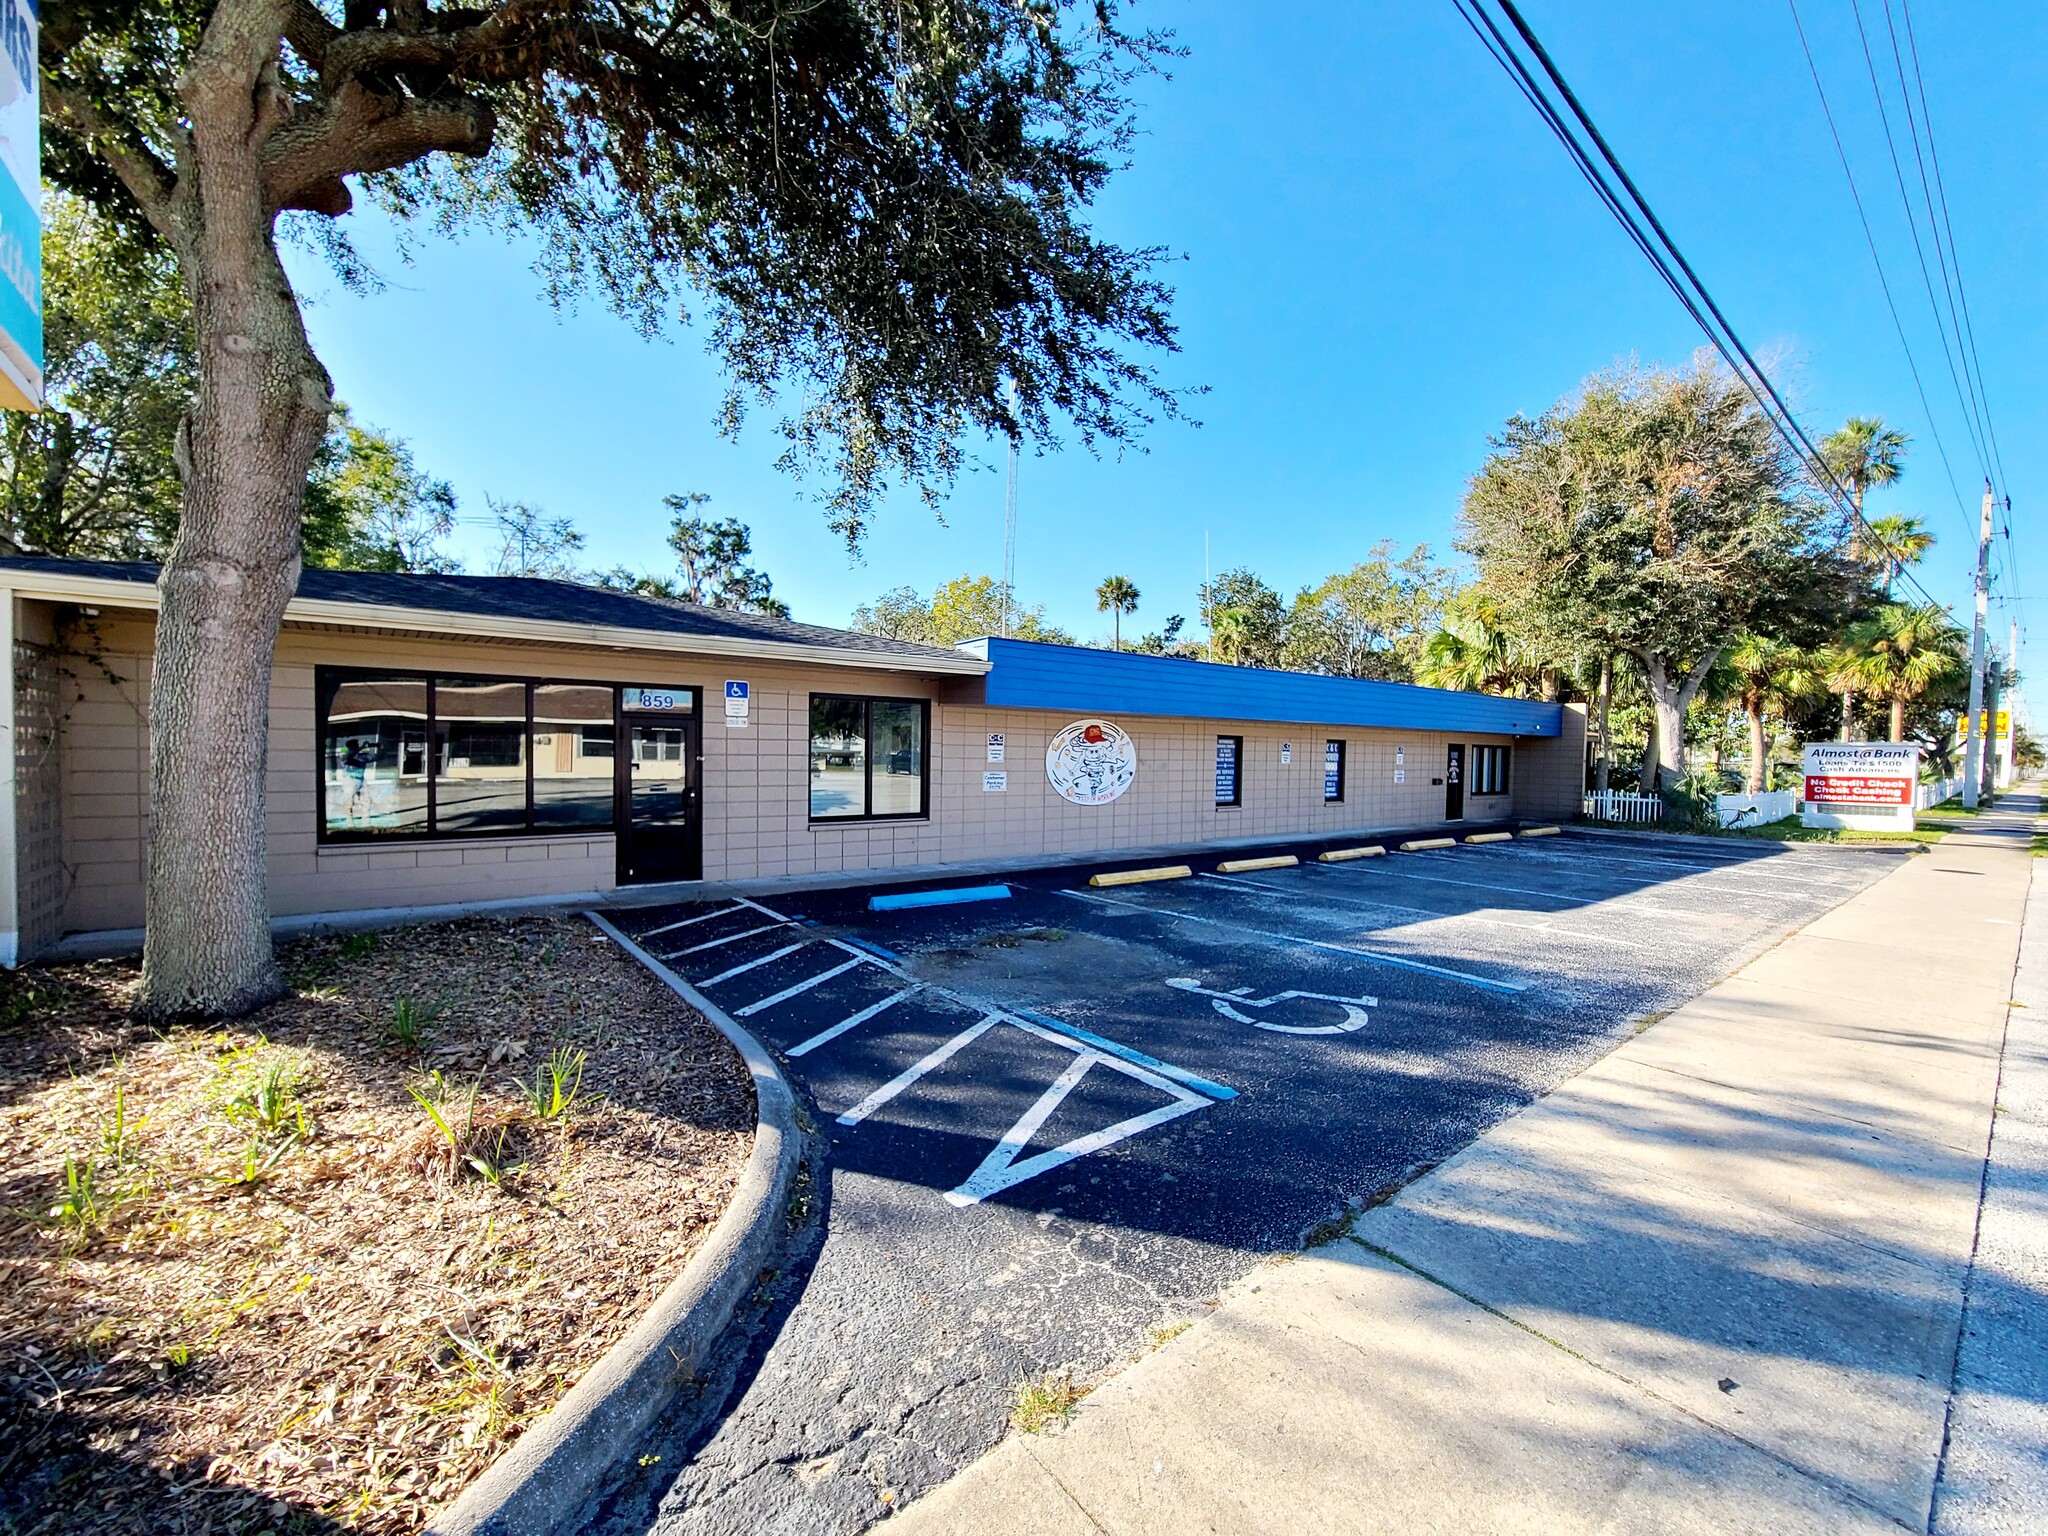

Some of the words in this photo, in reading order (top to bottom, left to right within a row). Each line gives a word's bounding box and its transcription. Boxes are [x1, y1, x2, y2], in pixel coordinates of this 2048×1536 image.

[642, 694, 674, 709] 859
[1811, 748, 1858, 758] Almost
[1874, 749, 1911, 758] Bank
[1829, 779, 1865, 787] Credit
[1867, 780, 1906, 788] Check
[1814, 786, 1850, 794] Check
[1852, 787, 1902, 796] Cashing
[1814, 794, 1902, 803] almostabank.com
